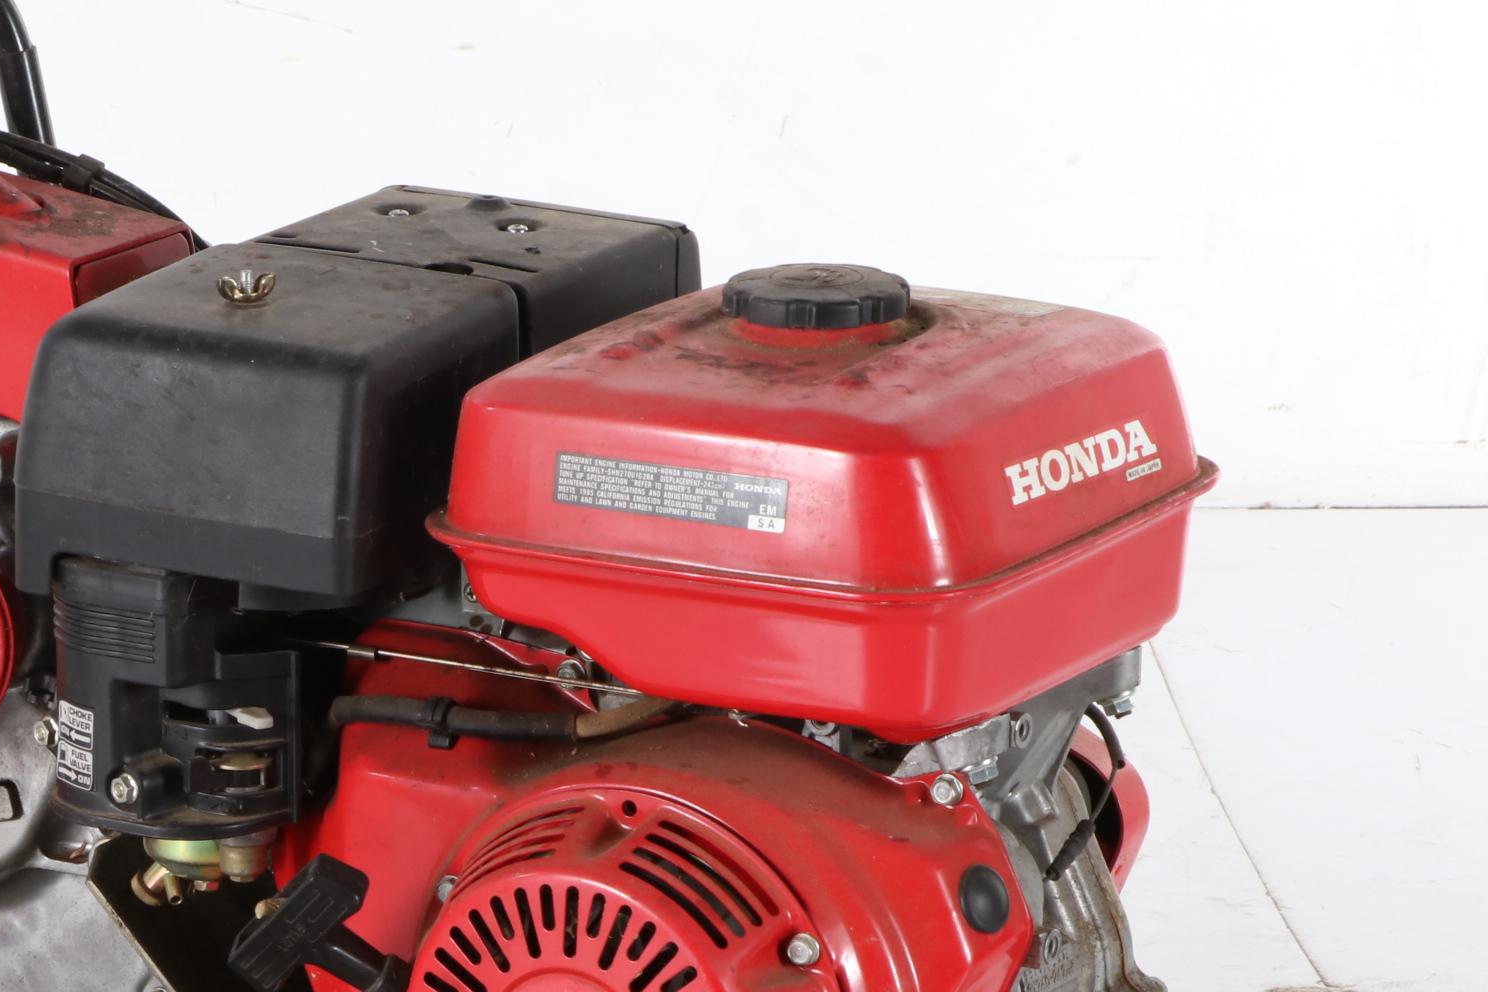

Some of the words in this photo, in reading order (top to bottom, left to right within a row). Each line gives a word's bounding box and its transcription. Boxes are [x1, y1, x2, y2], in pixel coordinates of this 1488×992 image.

[560, 462, 580, 471] ENGINE
[560, 455, 592, 464] IMPORTANT
[595, 459, 616, 468] ENGINE
[683, 471, 703, 479] MOTOR
[1005, 419, 1157, 505] HONDA
[587, 474, 628, 485] SPECIFICATION
[664, 484, 691, 494] OWNER'S
[695, 489, 719, 497] MANUAL
[734, 483, 782, 496] HONDA
[559, 477, 597, 488] MAINTENANCE
[601, 483, 645, 495] SPECIFICATIONS
[711, 498, 724, 506] THIS
[728, 501, 749, 509] ENGINE
[557, 493, 577, 502] UTILITY
[581, 496, 592, 504] AND
[596, 498, 611, 506] LAWN
[630, 503, 652, 512] GARDEN
[656, 507, 687, 517] EQUIPMENT
[597, 491, 630, 501] CALIFORNIA
[633, 496, 661, 505] EMISSION
[664, 500, 702, 511] REGULATIONS
[759, 505, 777, 517] EM
[68, 707, 92, 721] CHOKE
[68, 717, 91, 730] LEVER
[72, 750, 88, 761] FUEL
[70, 759, 91, 772] VALVE
[78, 774, 90, 785] ON
